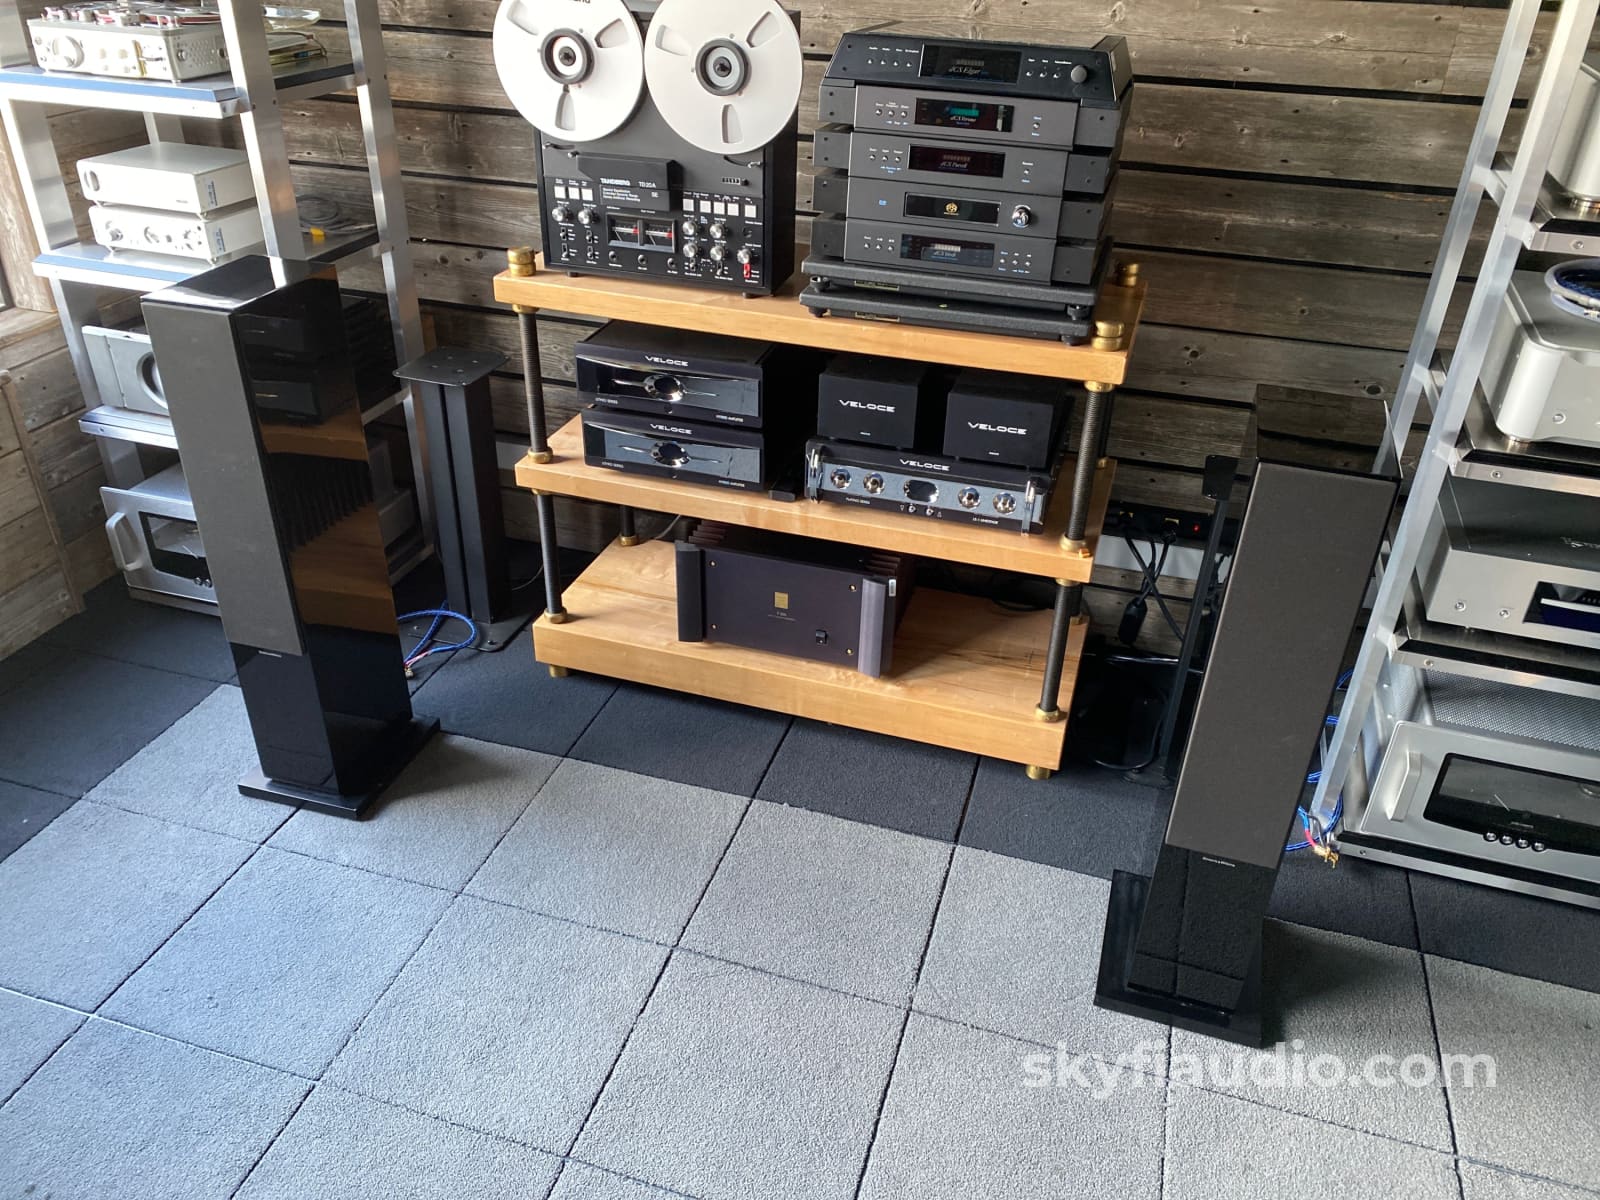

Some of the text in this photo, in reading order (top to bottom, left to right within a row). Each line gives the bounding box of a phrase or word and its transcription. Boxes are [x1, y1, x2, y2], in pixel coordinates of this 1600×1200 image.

[644, 355, 689, 367] VELOCE
[839, 399, 896, 413] VELOCE
[650, 423, 693, 435] VELOCE
[967, 421, 1028, 435] VELOCE
[900, 458, 950, 472] VELOCE
